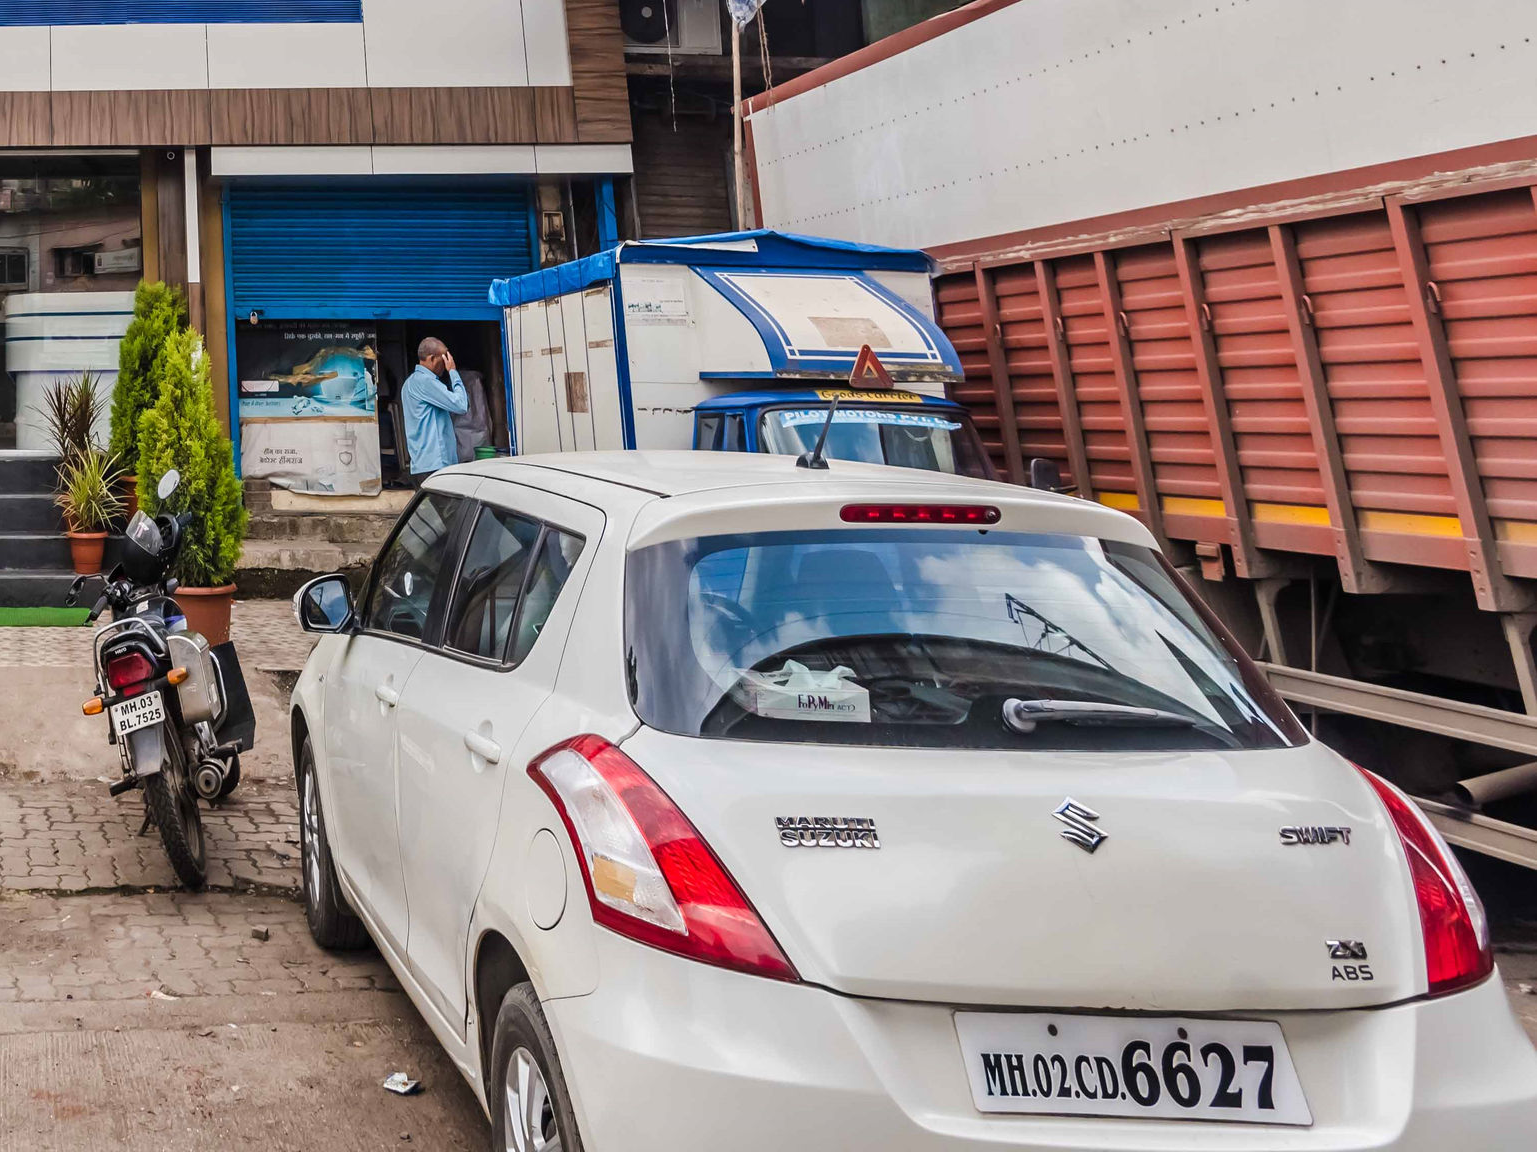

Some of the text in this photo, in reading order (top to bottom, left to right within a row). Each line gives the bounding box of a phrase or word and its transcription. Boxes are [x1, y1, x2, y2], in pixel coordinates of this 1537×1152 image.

[784, 410, 829, 420] PILOT
[120, 695, 153, 716] MH.03
[119, 708, 162, 731] BL.7525
[774, 816, 876, 830] MARUTI
[779, 829, 882, 850] SUZUKI
[1278, 825, 1352, 846] SWIFT
[1331, 964, 1374, 982] ABS
[980, 1040, 1275, 1110] MH.02.CD.6627
